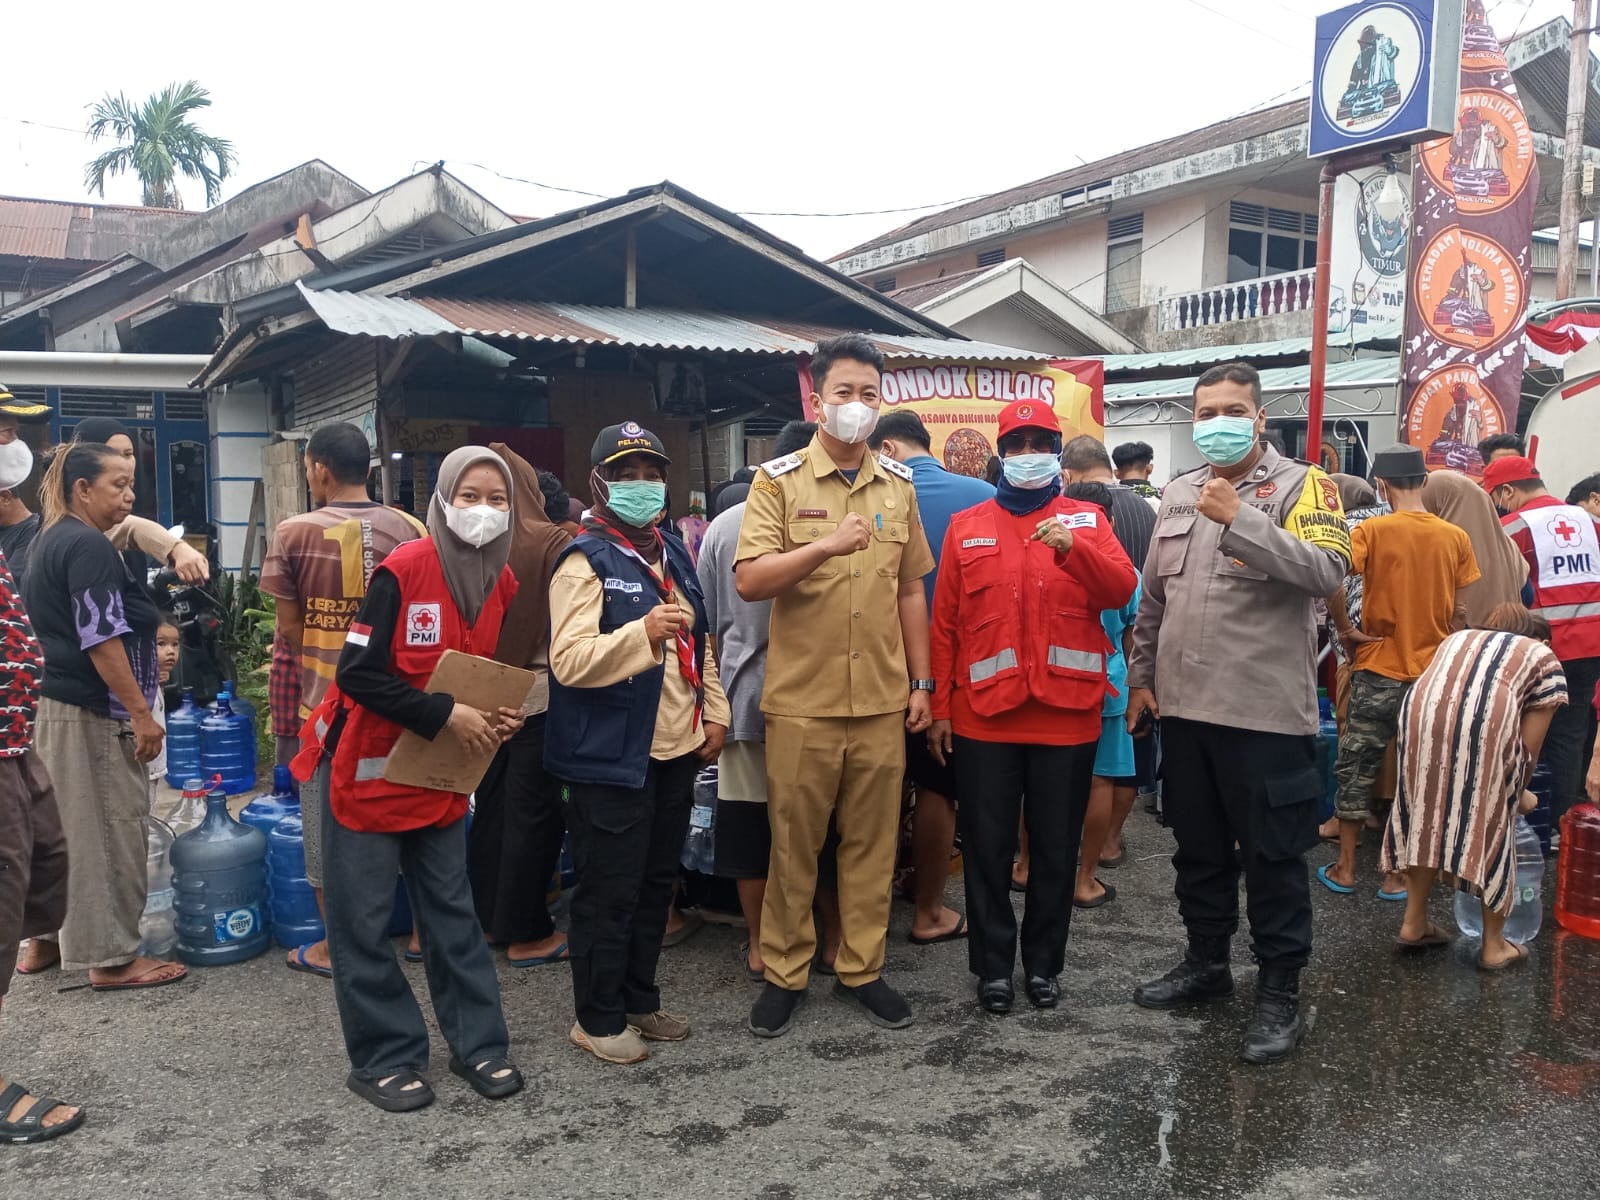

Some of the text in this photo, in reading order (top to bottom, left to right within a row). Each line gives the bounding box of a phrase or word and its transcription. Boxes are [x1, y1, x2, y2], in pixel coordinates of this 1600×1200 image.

[1371, 257, 1402, 273] TIMUR
[1421, 234, 1456, 291] PEMADAM
[881, 366, 972, 404] ONDOK
[921, 414, 957, 424] ASANYA
[1411, 379, 1443, 432] PEMADAM
[617, 438, 652, 447] PELATIH
[323, 519, 364, 598] 1
[361, 518, 374, 592] OMOR URUT
[1553, 553, 1592, 575] PMI
[411, 632, 437, 643] PMI
